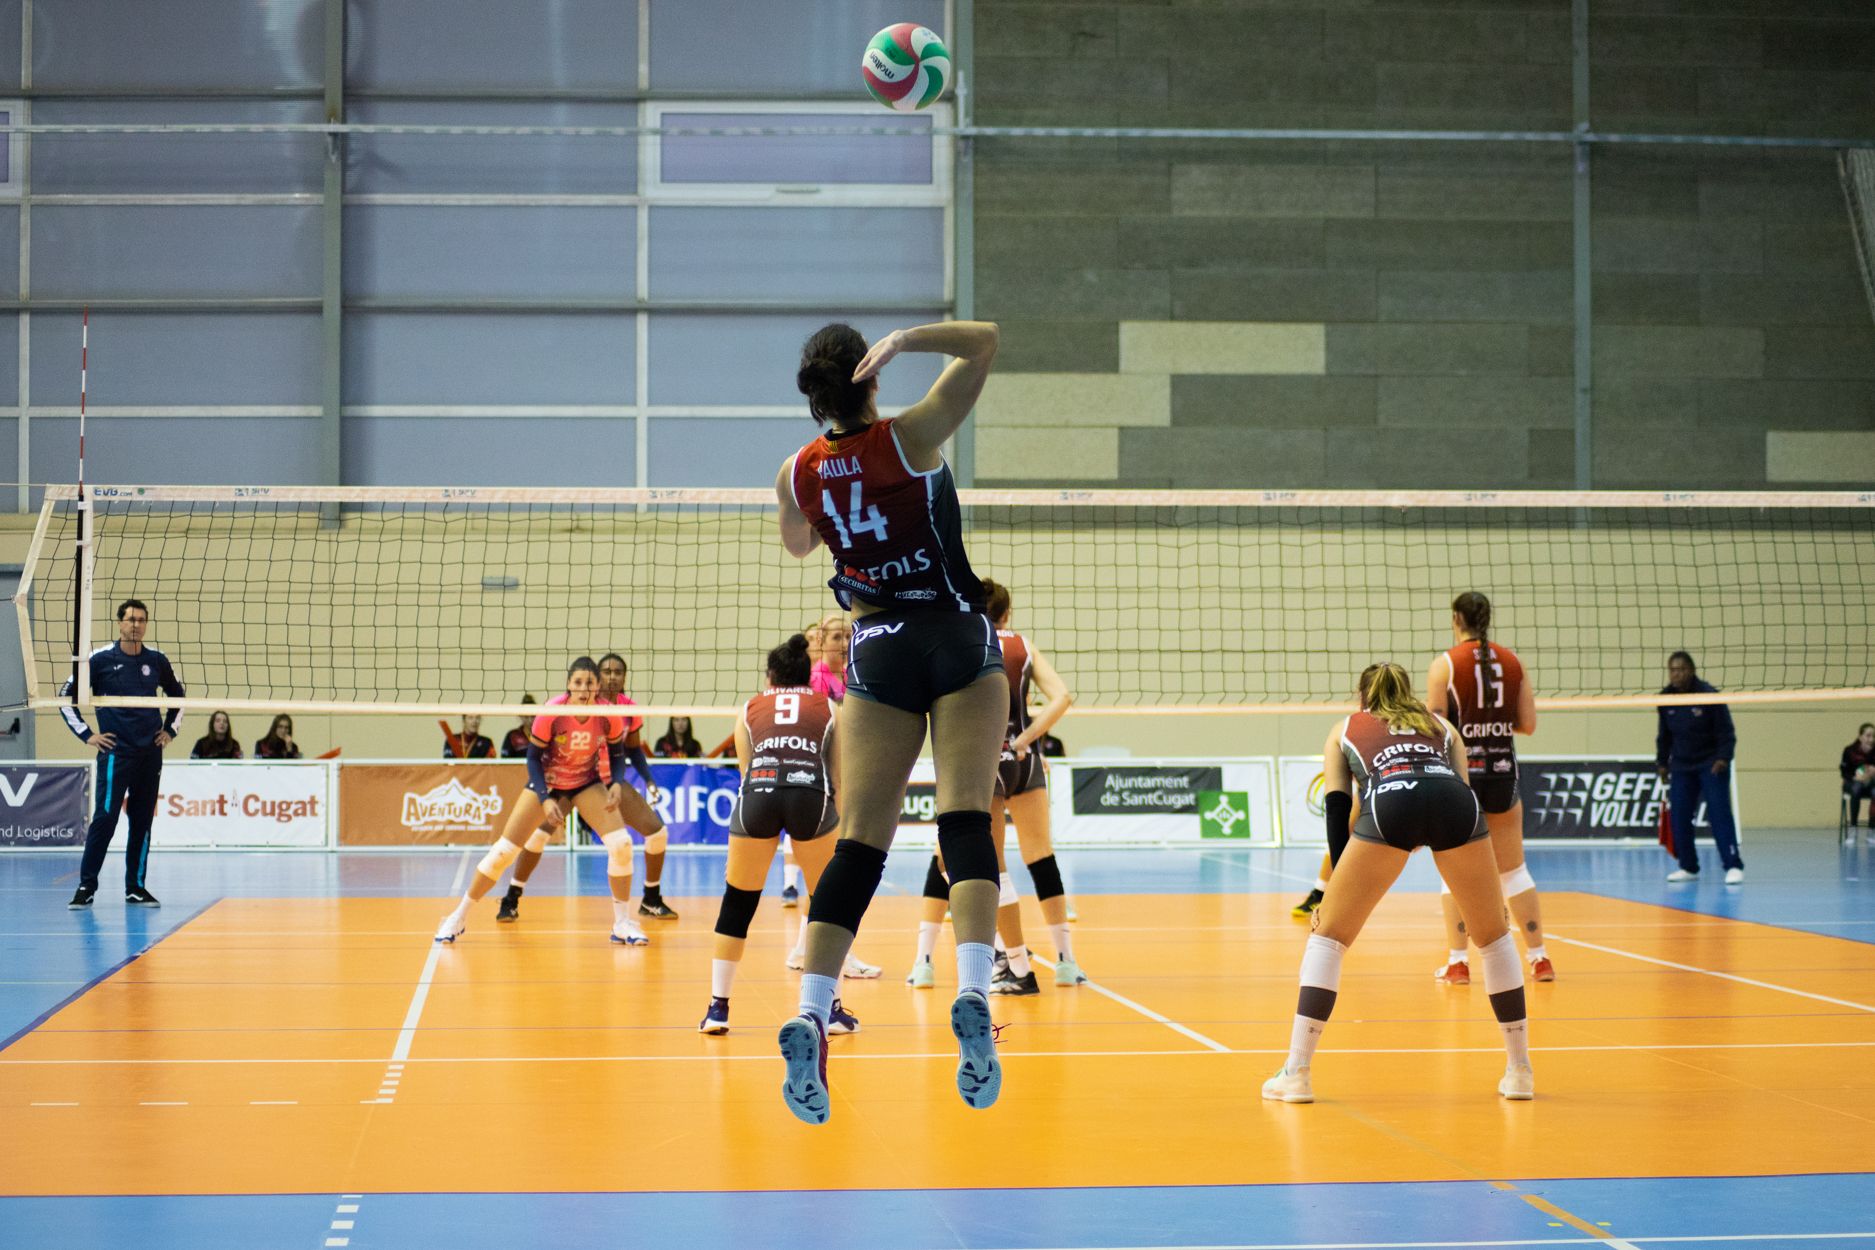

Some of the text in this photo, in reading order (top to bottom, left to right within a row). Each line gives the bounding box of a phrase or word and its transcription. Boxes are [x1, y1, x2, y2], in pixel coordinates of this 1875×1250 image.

[870, 52, 895, 79] molten
[822, 480, 888, 549] 14
[841, 576, 877, 595] SECURITAS
[854, 622, 905, 646] DSV
[774, 694, 800, 725] 9
[1462, 722, 1513, 738] GRIFOLS
[570, 730, 592, 751] 22
[754, 736, 818, 754] GRIFOLS
[1105, 774, 1190, 791] Ajuntament
[1376, 780, 1419, 795] DSV
[168, 794, 228, 817] Sant
[242, 794, 319, 823] Cugat
[644, 785, 738, 828] RIFO
[1101, 790, 1195, 809] de SantCugat
[17, 825, 74, 841] Logistics
